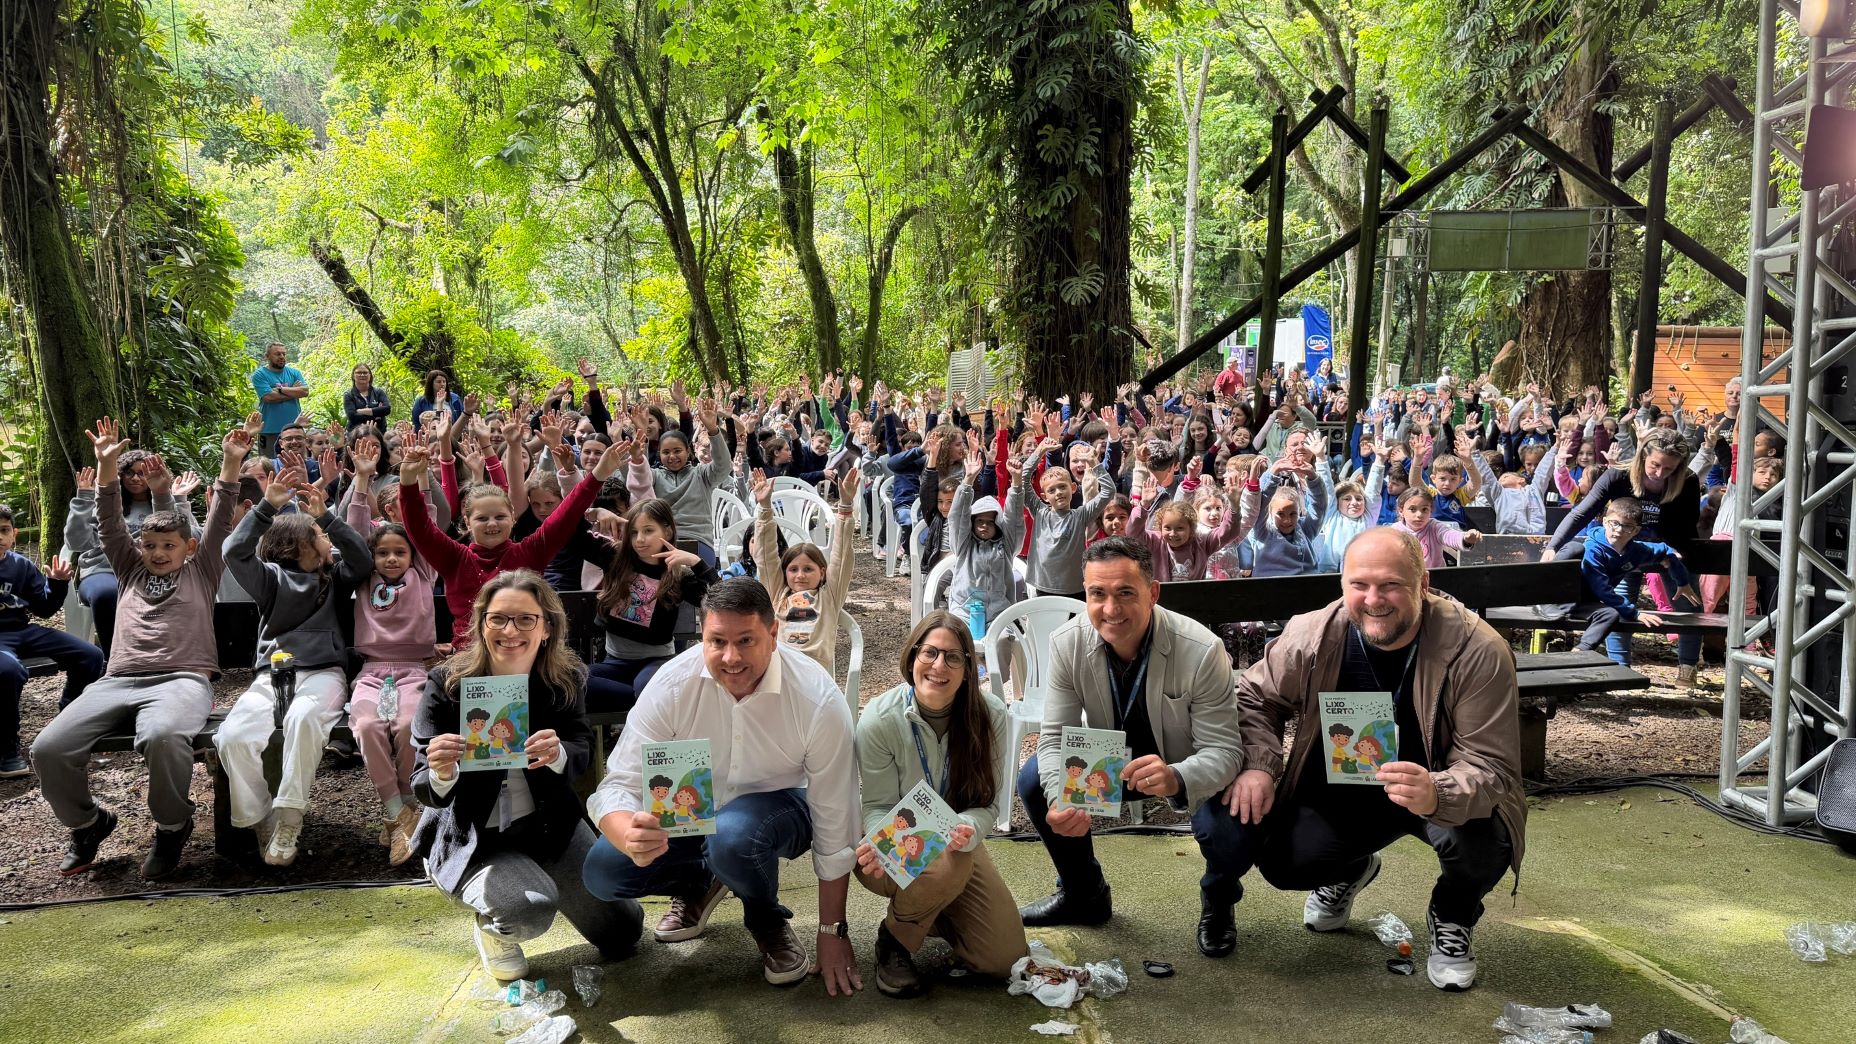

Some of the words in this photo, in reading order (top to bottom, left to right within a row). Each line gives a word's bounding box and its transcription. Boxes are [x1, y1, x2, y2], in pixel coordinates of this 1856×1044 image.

[1841, 375, 1848, 388] 2
[466, 685, 485, 693] LIXO
[466, 692, 493, 700] CERTO
[1325, 707, 1355, 715] CERTO
[1066, 741, 1092, 749] CERTO
[647, 751, 666, 759] LIXO
[647, 757, 675, 766] CERTO
[917, 789, 932, 805] LIXO
[912, 794, 933, 815] CERTO
